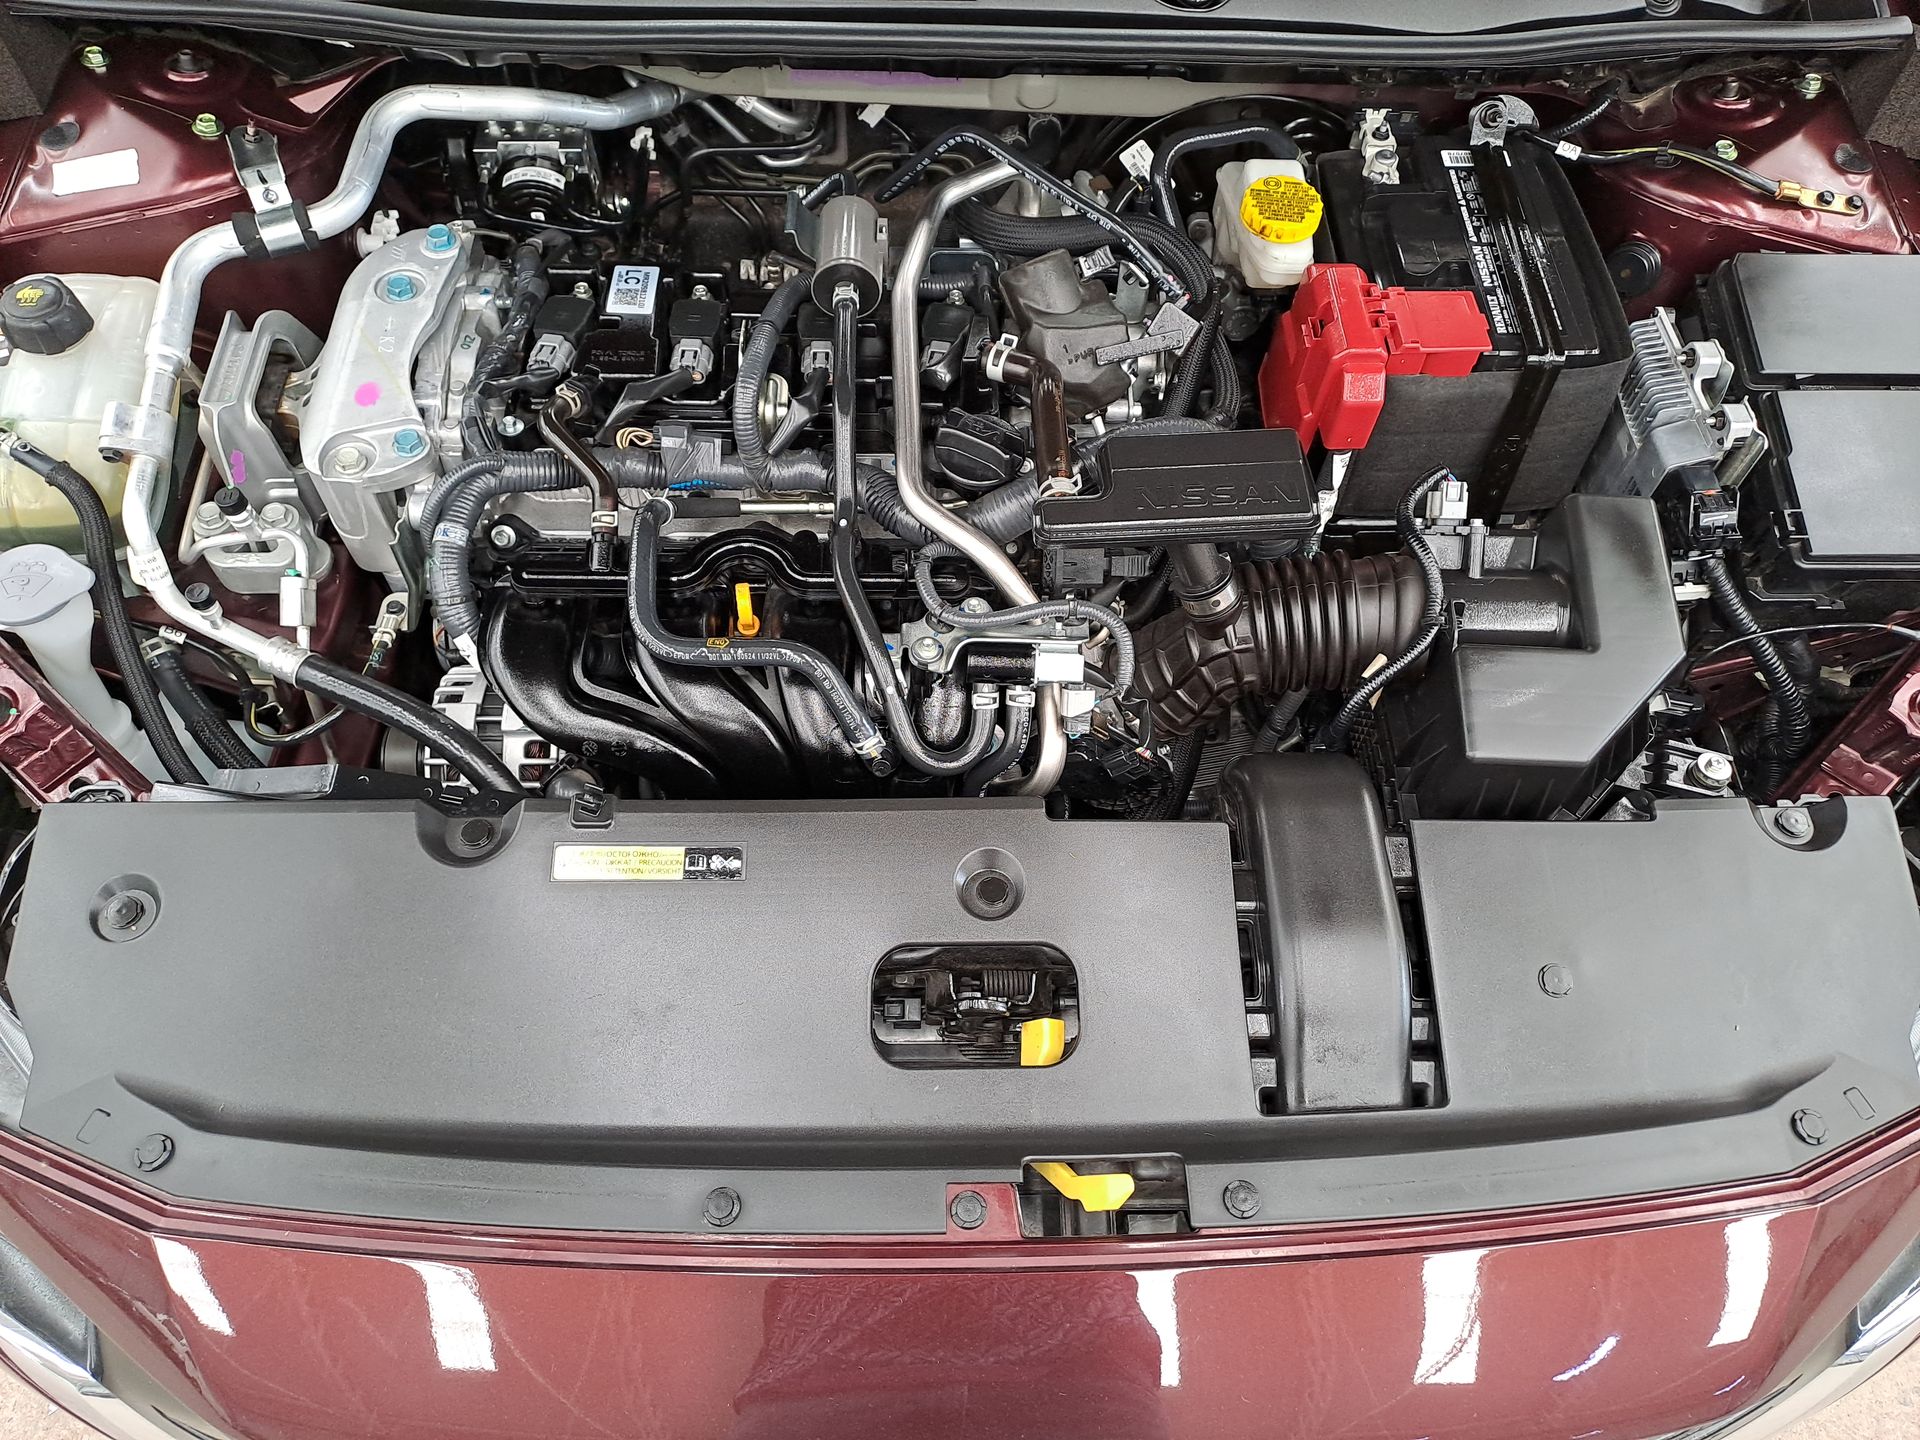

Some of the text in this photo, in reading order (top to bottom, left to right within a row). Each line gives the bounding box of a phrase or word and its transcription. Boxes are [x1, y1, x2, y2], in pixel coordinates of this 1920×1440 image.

[624, 269, 642, 285] LC
[1472, 245, 1493, 287] NISSAN
[1486, 294, 1507, 334] RENAULT
[1136, 481, 1300, 509] NISSAN
